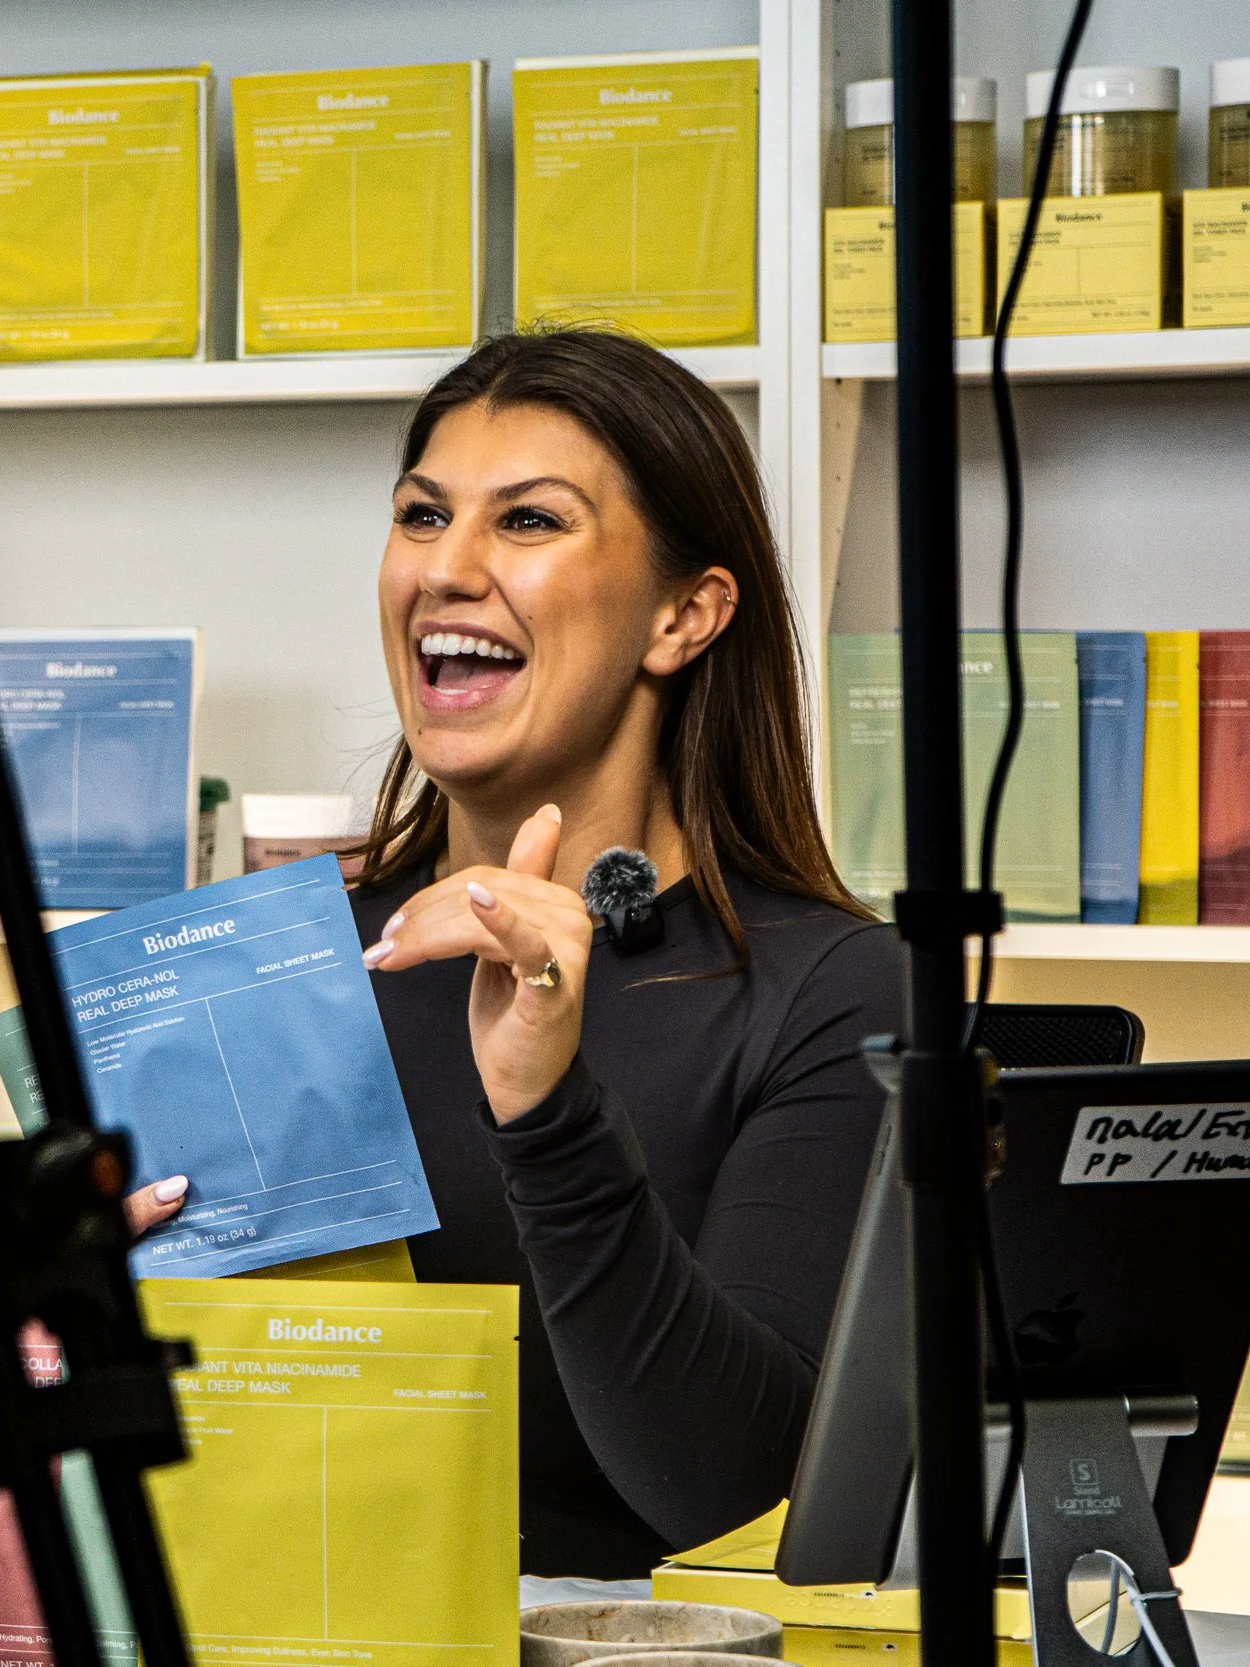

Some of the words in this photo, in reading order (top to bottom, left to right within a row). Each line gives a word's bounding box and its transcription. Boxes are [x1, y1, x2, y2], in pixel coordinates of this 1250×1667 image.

[142, 919, 236, 955] Biodance
[256, 961, 283, 975] FACIAL
[284, 955, 310, 968] SHEET
[311, 948, 335, 961] MASK
[71, 986, 116, 1008] HYDRO
[118, 969, 180, 994] CERA-NOL
[77, 1005, 111, 1023] REAL
[111, 994, 143, 1013] DEEP
[144, 985, 179, 1004] MASK
[153, 1243, 174, 1256] NET
[176, 1238, 194, 1251] WT.
[196, 1235, 216, 1247] 1.19
[218, 1232, 229, 1243] oz
[230, 1228, 246, 1242] (34
[247, 1226, 257, 1238] g)
[268, 1318, 383, 1343] Biodance
[233, 1361, 263, 1374] VITA
[266, 1363, 362, 1378] NIACINAMIDE
[207, 1379, 245, 1393] DEEP
[249, 1381, 291, 1394] MASK
[0, 1633, 35, 1645] Hydrating,
